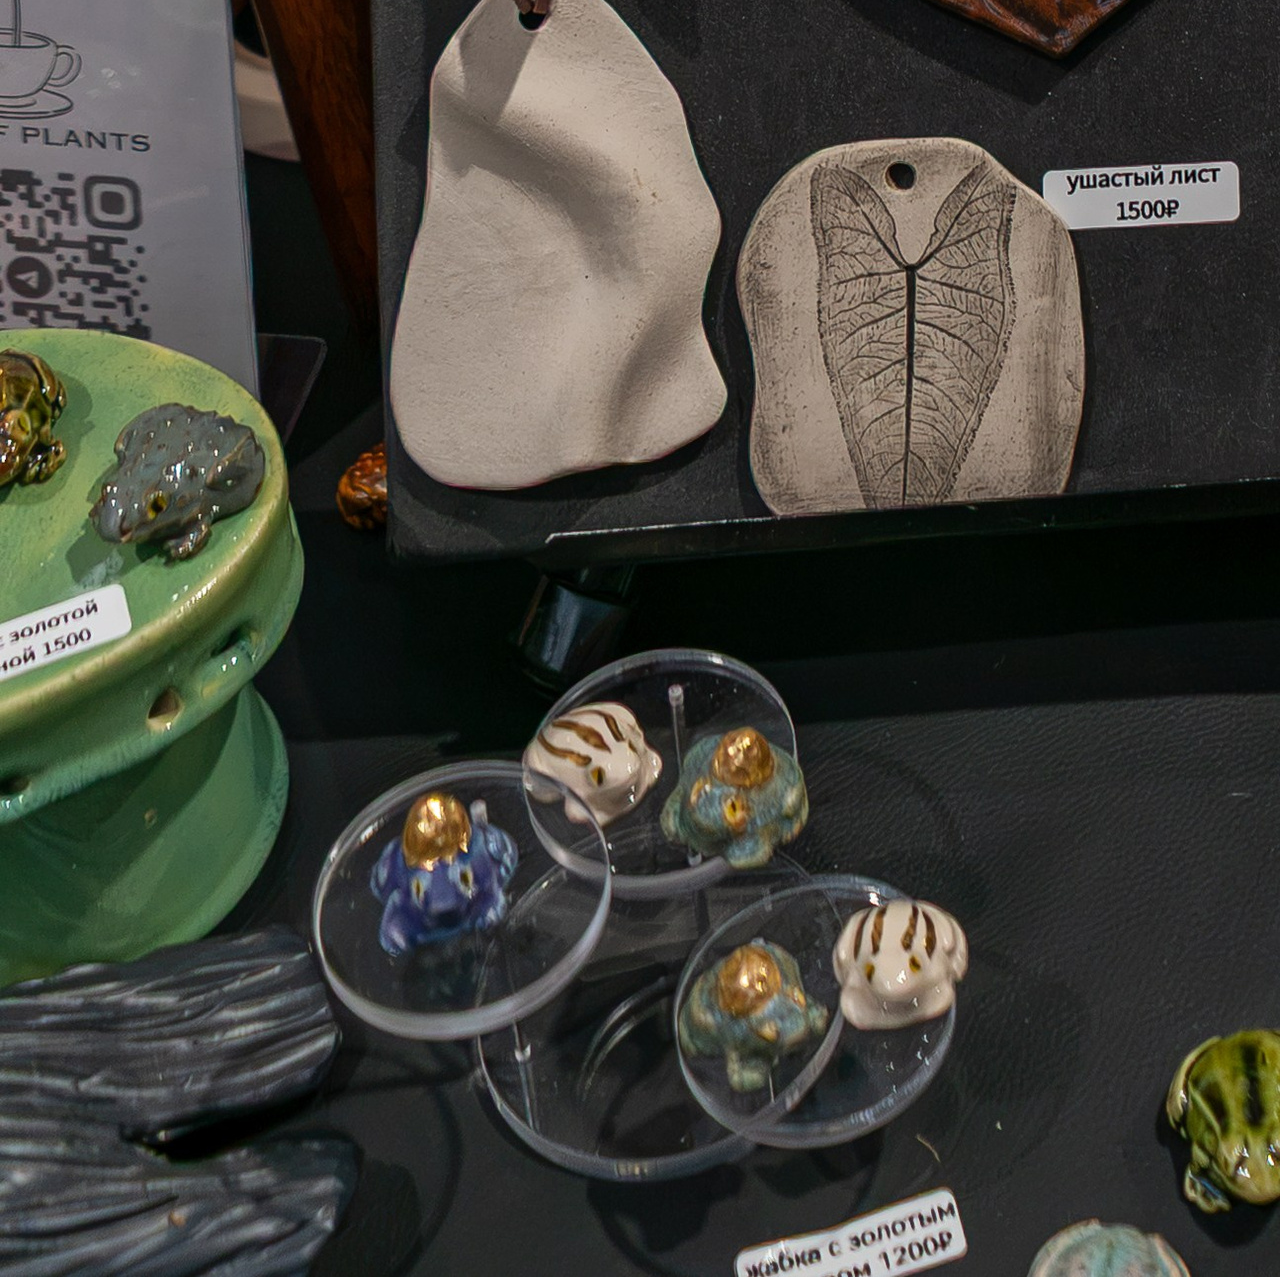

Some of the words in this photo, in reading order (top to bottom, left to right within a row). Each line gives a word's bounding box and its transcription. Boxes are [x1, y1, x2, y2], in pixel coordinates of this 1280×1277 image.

[21, 126, 151, 152] PLANTS
[1066, 165, 1164, 195] ушастый
[1169, 167, 1221, 185] лист
[1116, 199, 1180, 221] 1500₽
[9, 598, 98, 642] золотой
[43, 628, 92, 656] 1500
[849, 1202, 955, 1252] золотым
